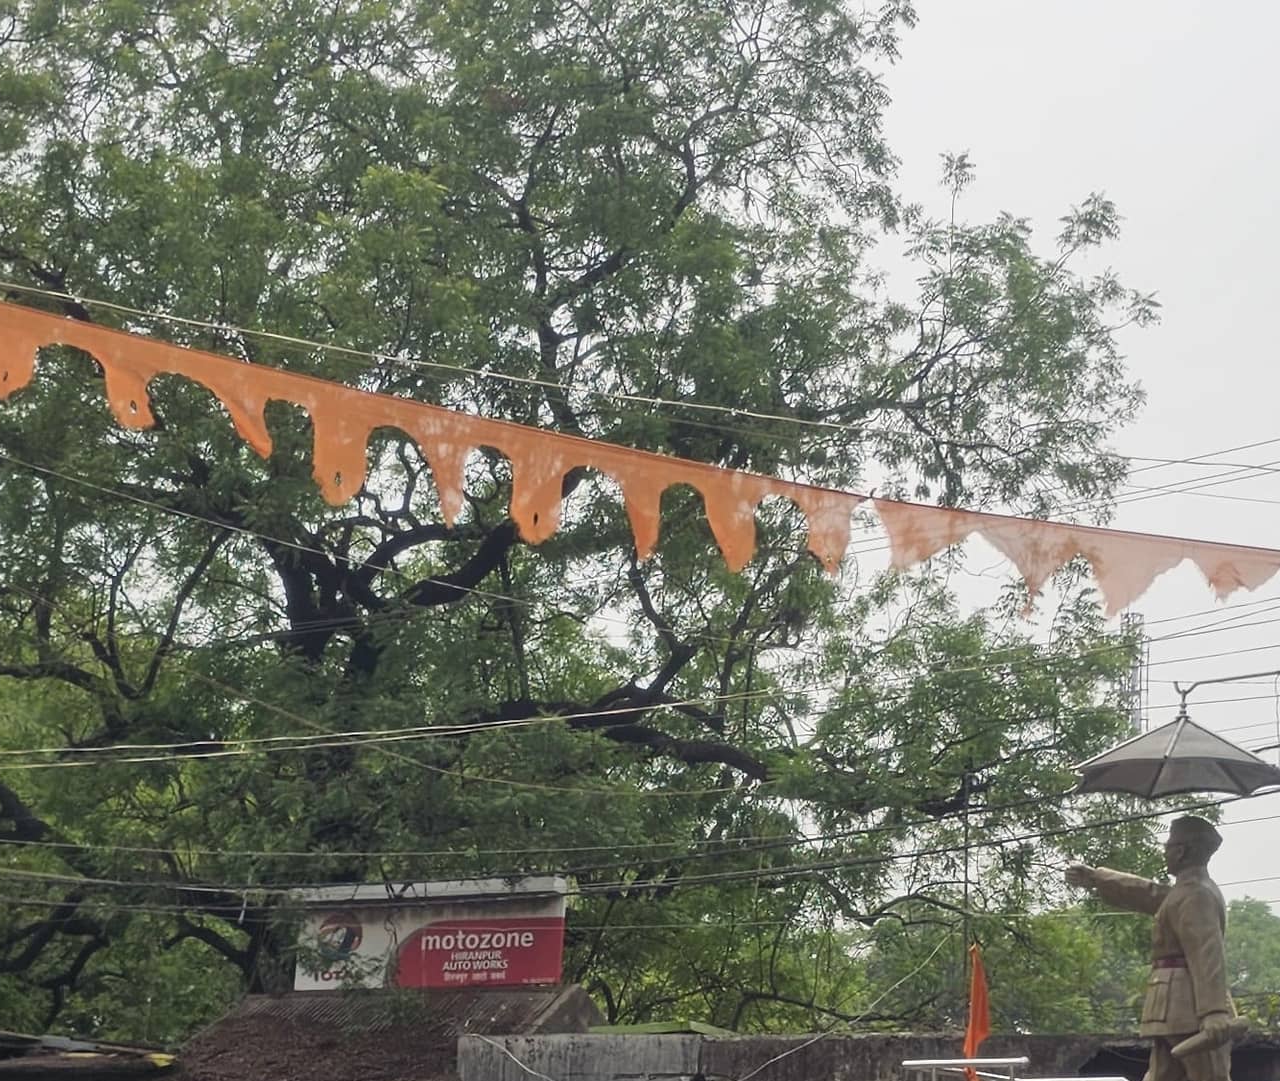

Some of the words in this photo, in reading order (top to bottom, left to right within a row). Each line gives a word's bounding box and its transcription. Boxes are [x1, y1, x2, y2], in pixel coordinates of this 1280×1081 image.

[421, 930, 534, 950] motozone
[451, 951, 502, 961] HIRANPUR
[443, 961, 471, 970] AUTO
[473, 960, 508, 970] WORKS
